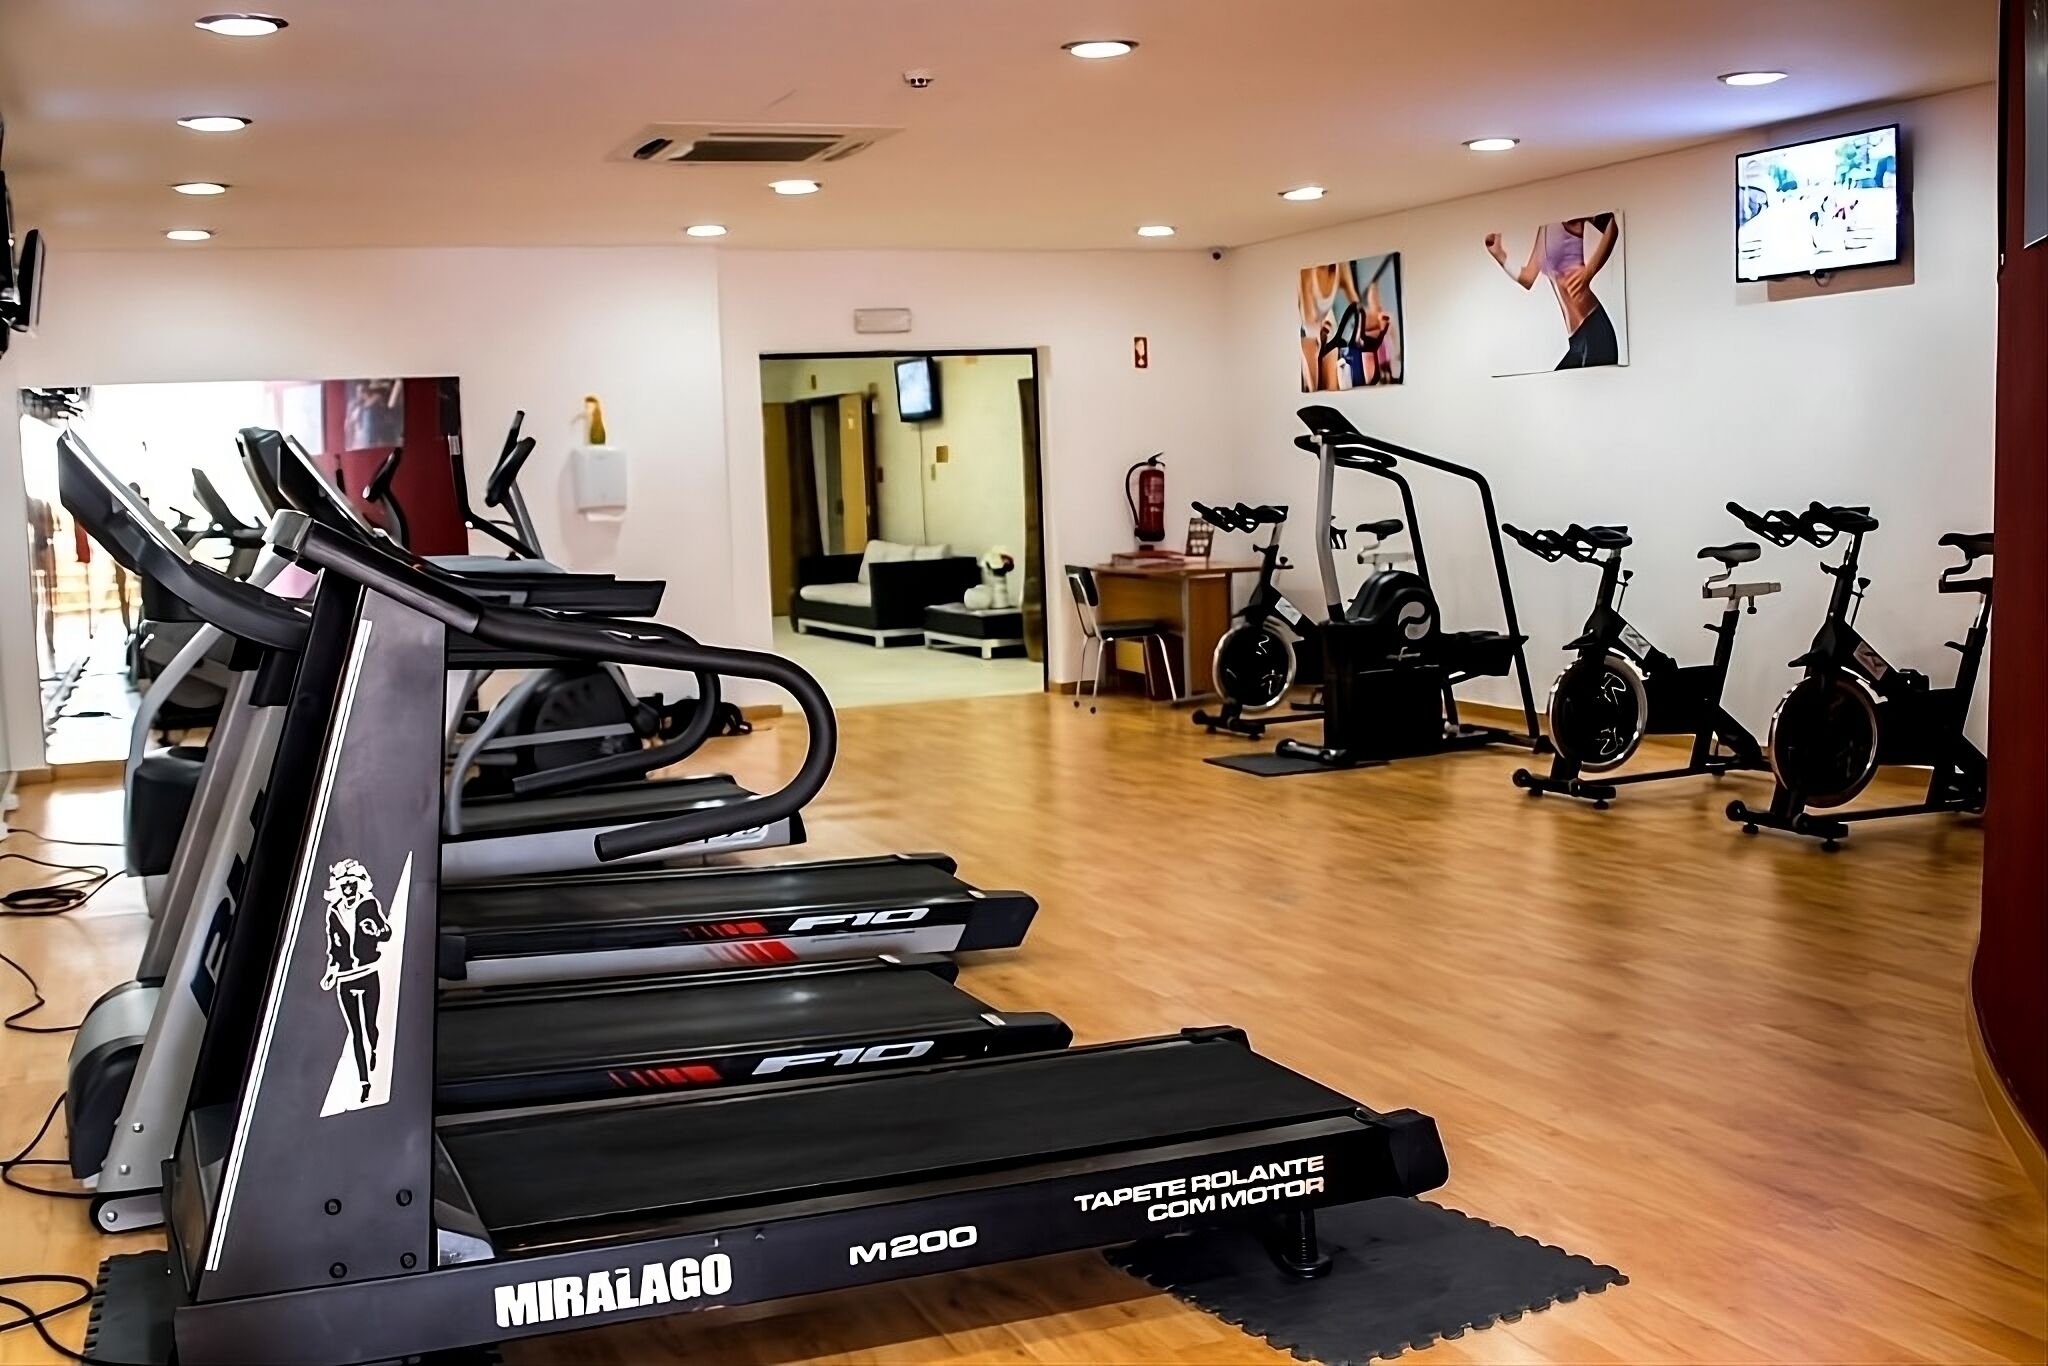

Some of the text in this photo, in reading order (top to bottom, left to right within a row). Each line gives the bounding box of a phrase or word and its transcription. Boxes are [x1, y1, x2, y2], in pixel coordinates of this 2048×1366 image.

[788, 907, 930, 932] F10
[751, 1040, 935, 1076] F10
[1073, 1155, 1325, 1212] TAPETE ROLANTE
[1147, 1176, 1325, 1222] COM MOTOR
[849, 1225, 979, 1266] M200
[494, 1252, 733, 1329] MIRALAGO
